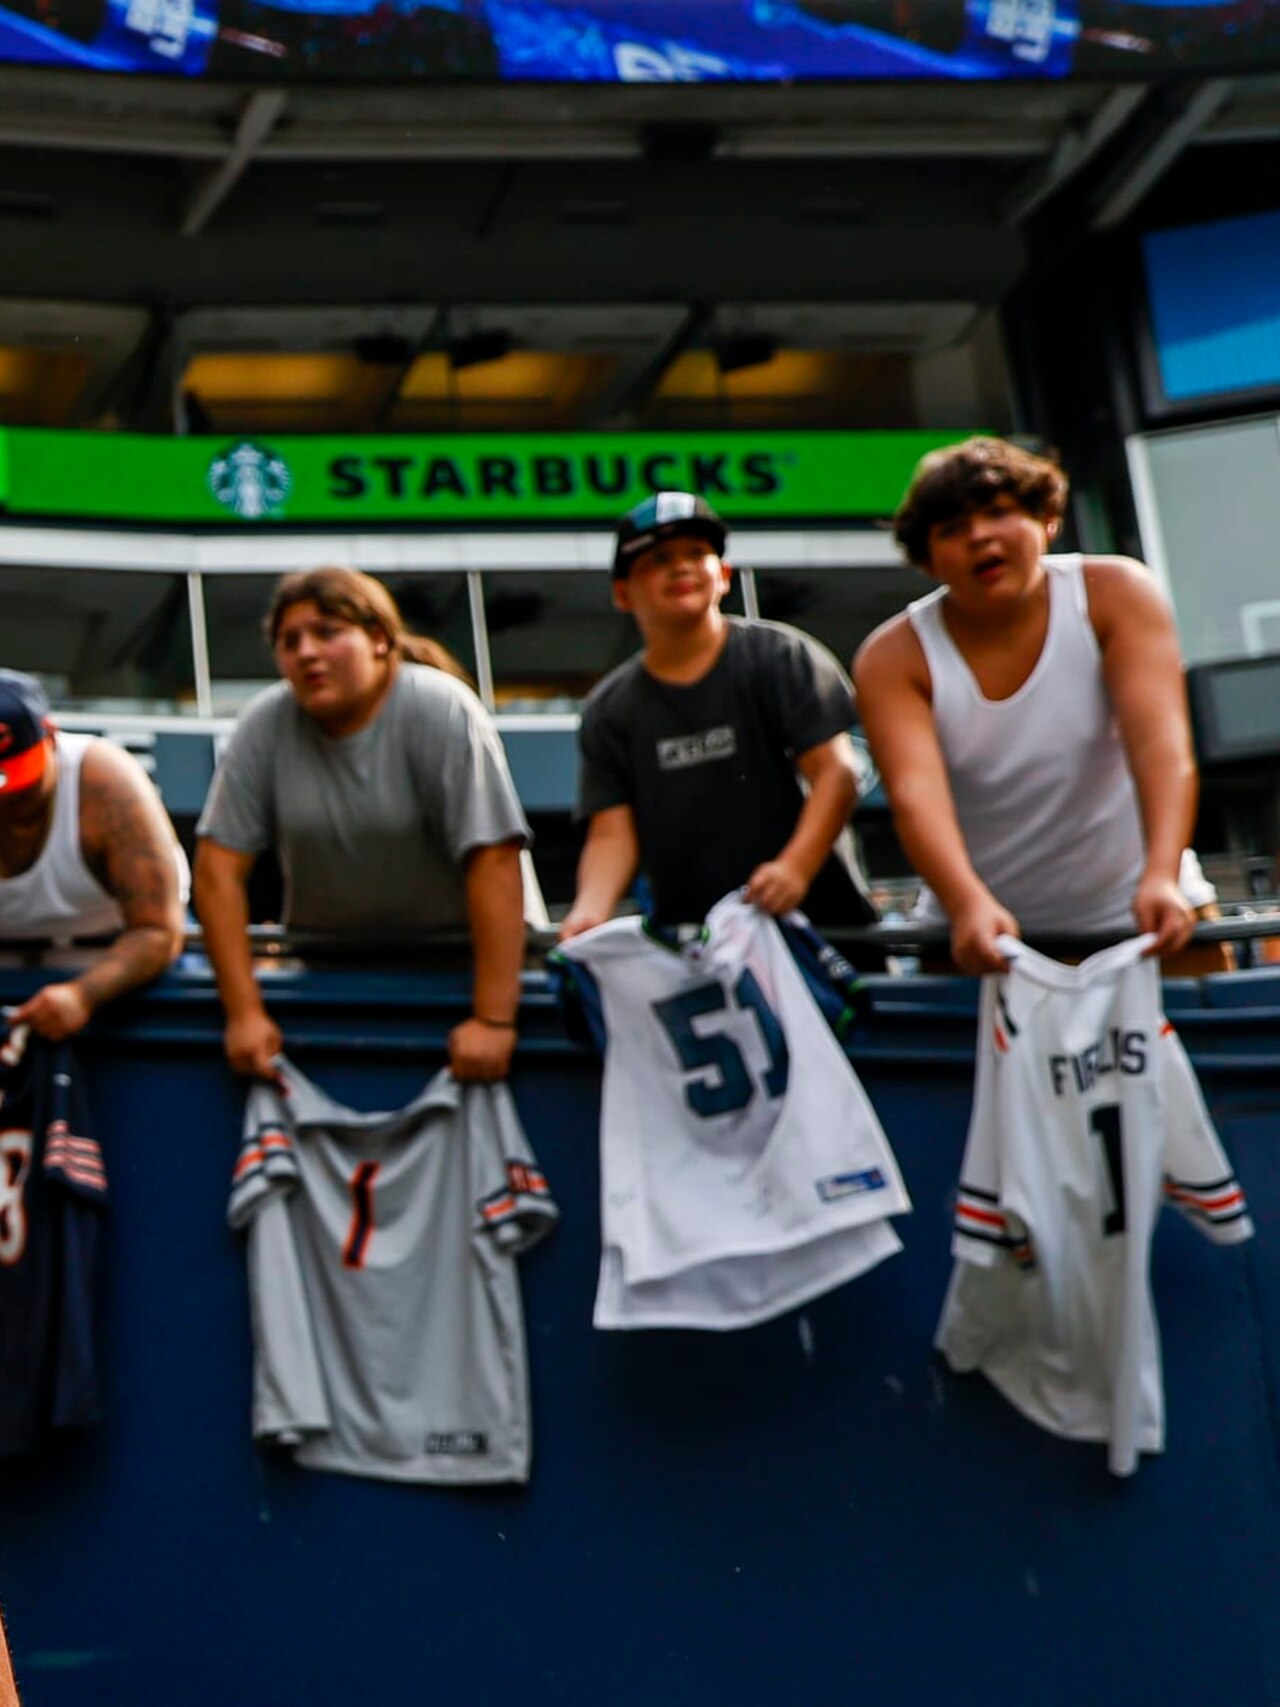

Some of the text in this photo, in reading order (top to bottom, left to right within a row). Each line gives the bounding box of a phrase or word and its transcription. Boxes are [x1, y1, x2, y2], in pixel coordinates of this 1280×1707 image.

[328, 453, 781, 500] STARBUCKS
[652, 966, 790, 1119] 51
[343, 1160, 380, 1271] 1
[1089, 1104, 1127, 1239] 1
